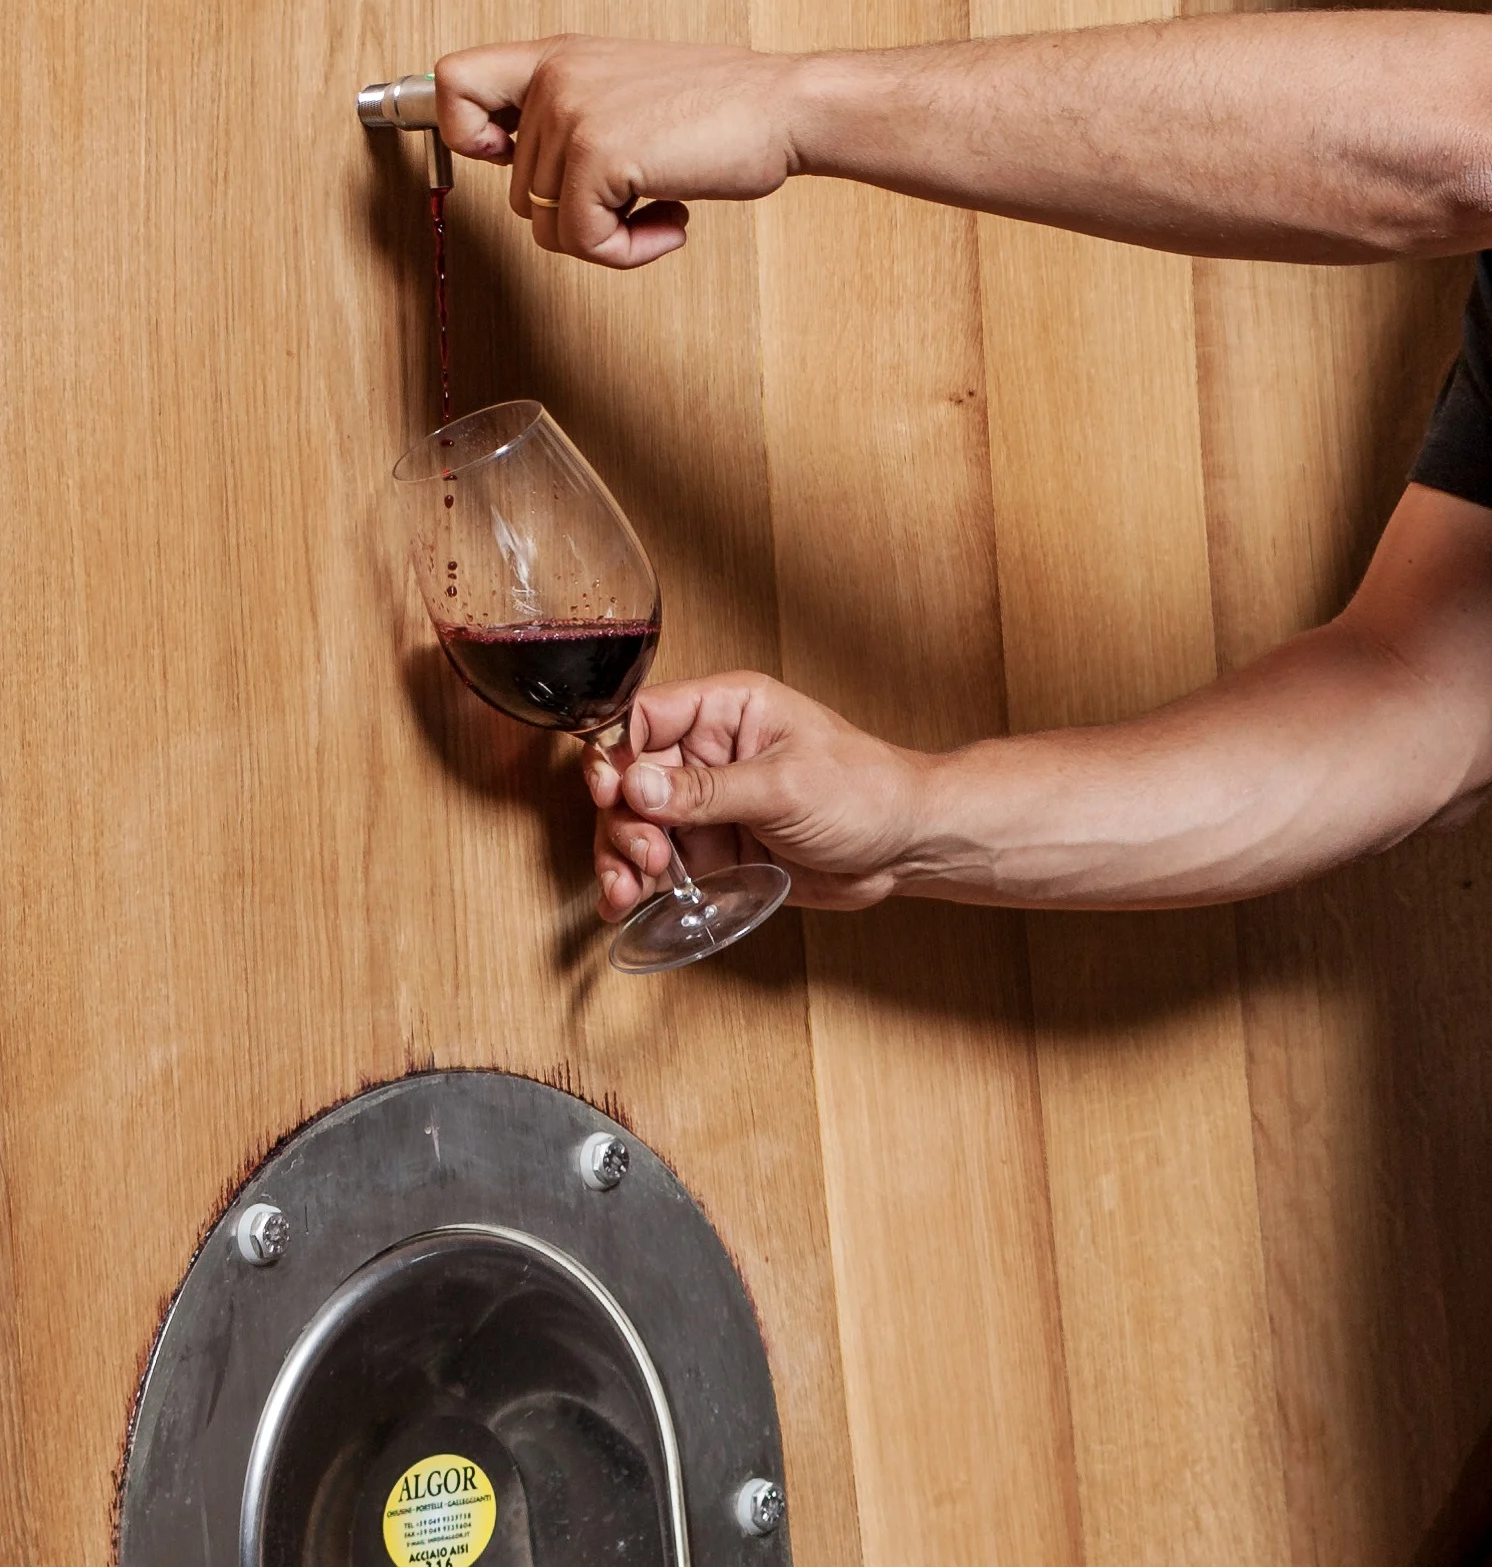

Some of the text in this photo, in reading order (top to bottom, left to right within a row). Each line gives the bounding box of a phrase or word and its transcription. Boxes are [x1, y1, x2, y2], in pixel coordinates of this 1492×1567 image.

[398, 1465, 478, 1503] ALGOR
[416, 1501, 443, 1513] PORTELLE
[409, 1543, 469, 1563] ACCIAIO AISI
